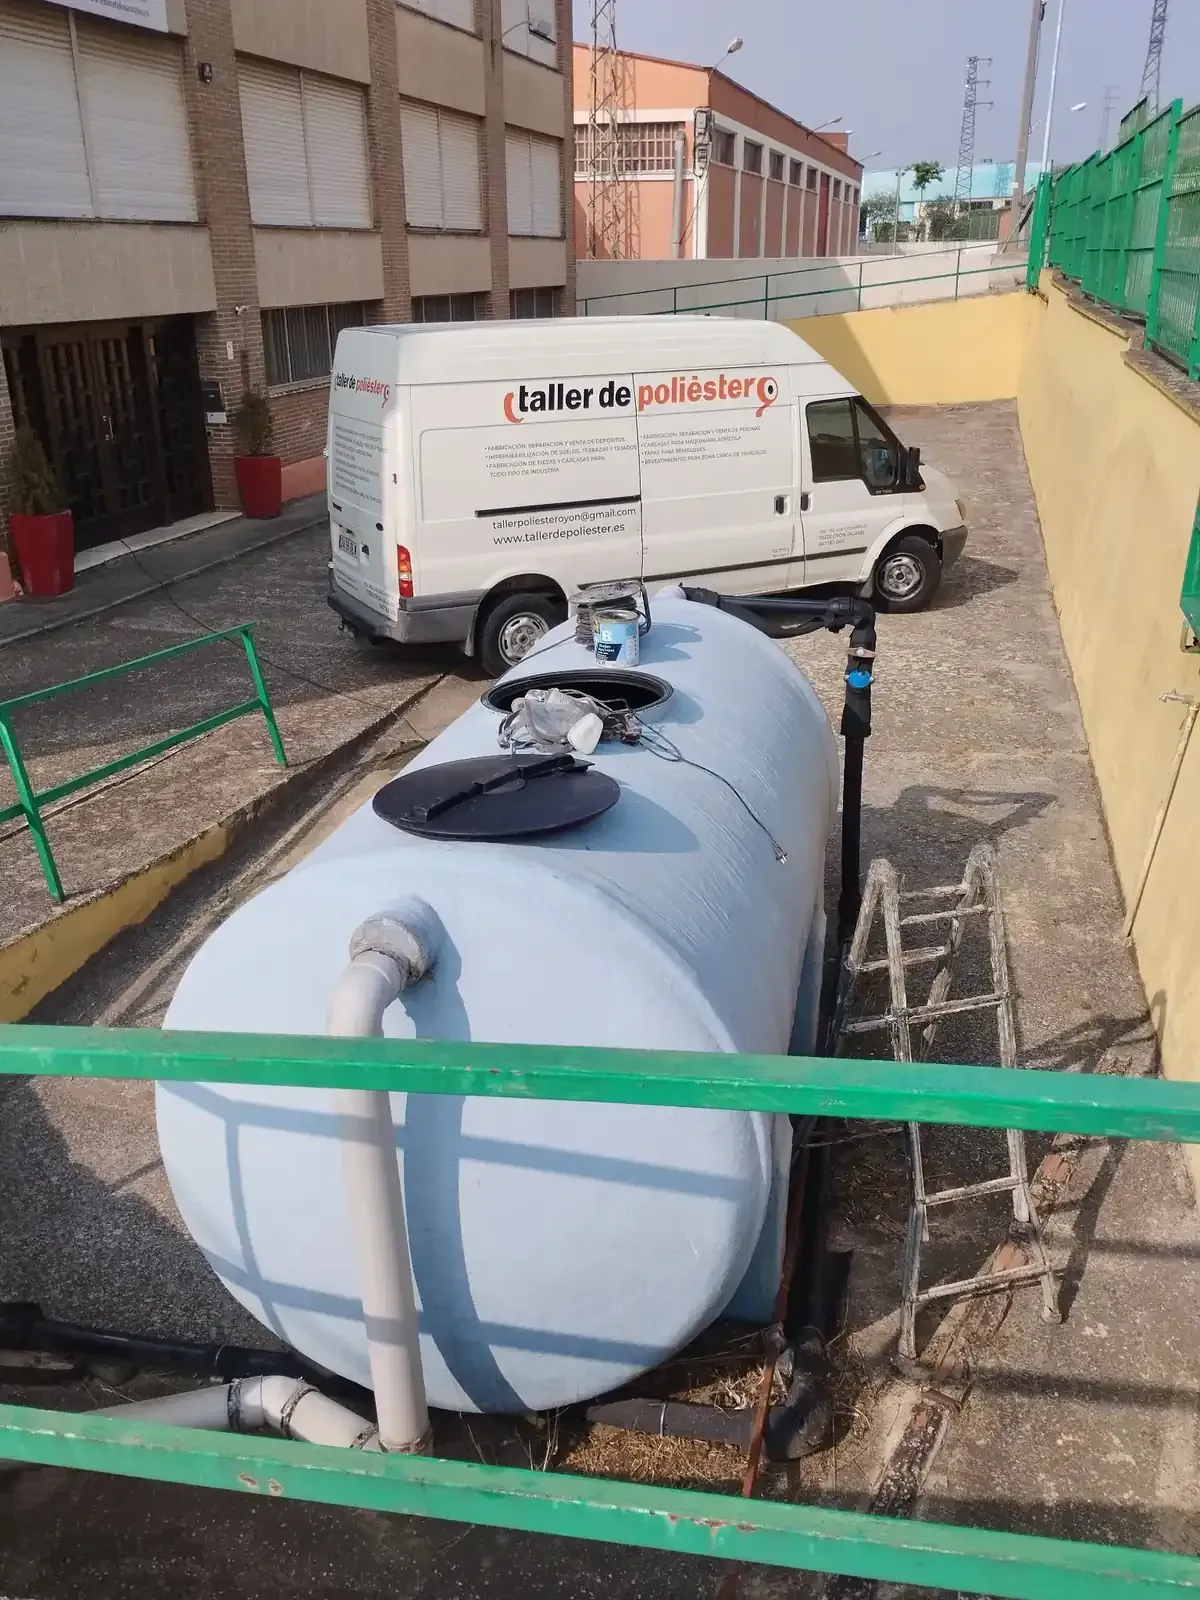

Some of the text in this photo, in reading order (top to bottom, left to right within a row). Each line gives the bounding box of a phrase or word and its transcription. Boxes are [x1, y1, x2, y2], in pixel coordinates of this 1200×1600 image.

[518, 373, 756, 413] taller de poliéster
[492, 508, 636, 530] tallerpoliesteroyon@gmail.com
[493, 523, 625, 545] www.tallerdepoliester.es
